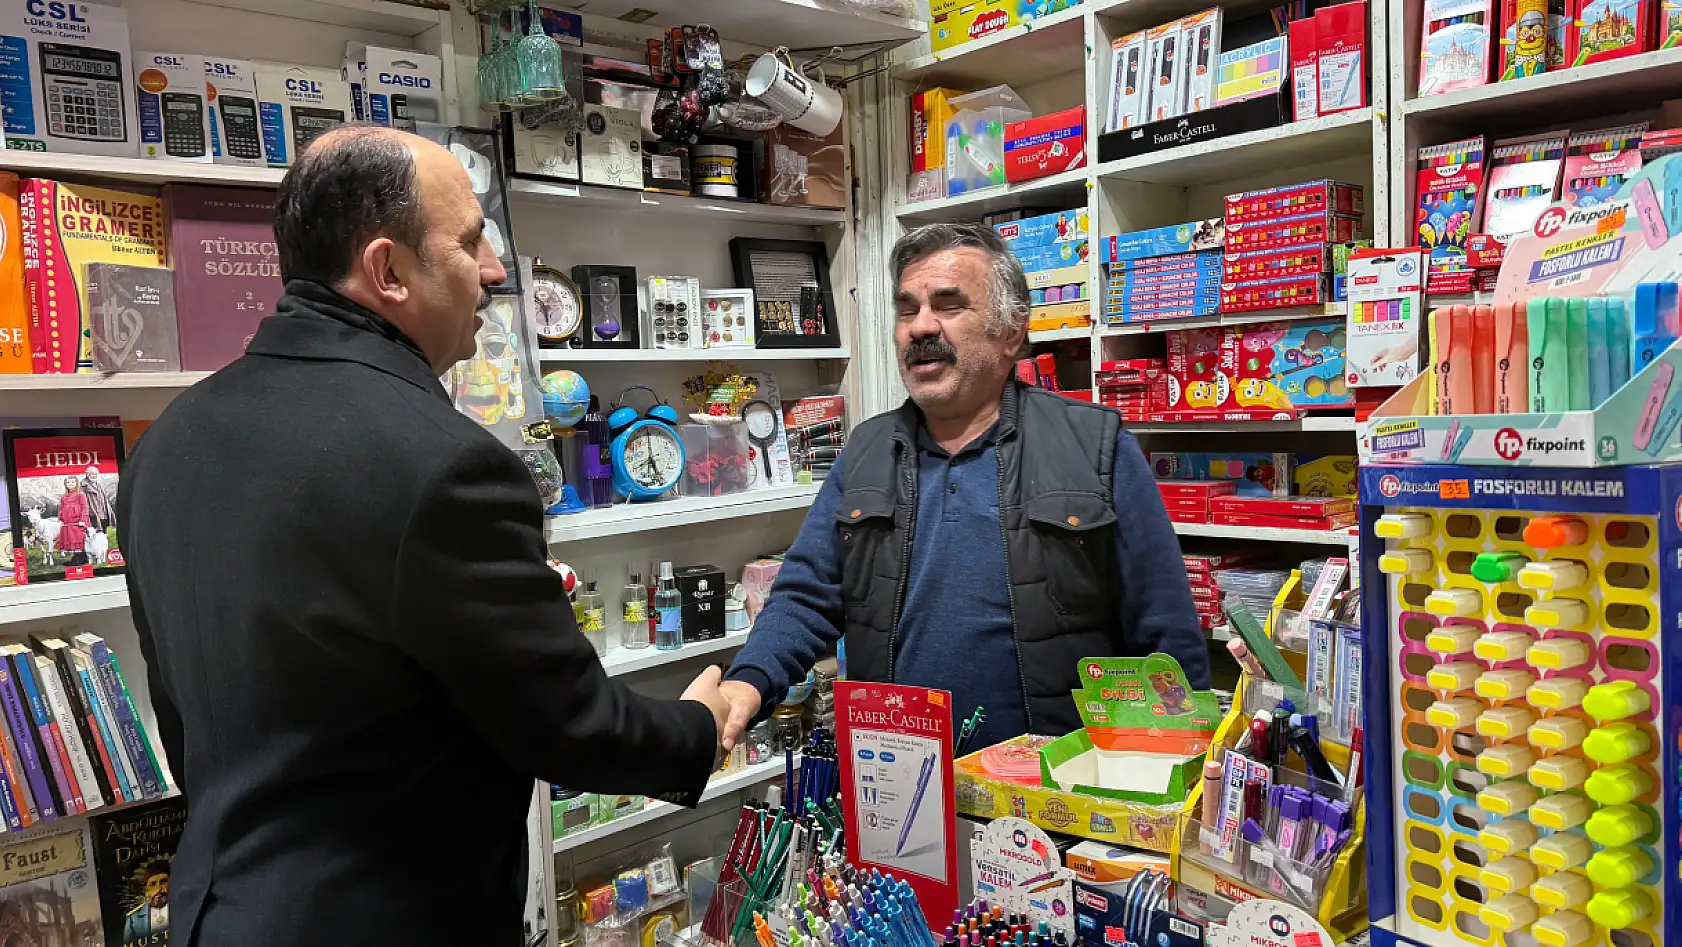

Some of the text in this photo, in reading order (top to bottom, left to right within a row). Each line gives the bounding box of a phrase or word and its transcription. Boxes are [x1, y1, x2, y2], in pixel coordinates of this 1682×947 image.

[26, 0, 86, 22] CSL
[968, 15, 1009, 35] PLAY DOUGH
[1223, 43, 1272, 63] ACRYLIC
[1318, 43, 1363, 56] FABER-CASTELL
[153, 55, 182, 66] CSL
[285, 78, 322, 93] CSL
[378, 72, 431, 89] CASIO
[1153, 123, 1217, 145] FABER-CASTELL
[20, 192, 32, 270] GRAMER
[62, 213, 155, 239] GRAMER
[62, 231, 114, 243] FUNDAMENTALS
[1544, 232, 1615, 257] PASTEL RENKLER
[1539, 243, 1614, 276] FOSFORLU KALEM
[1357, 323, 1391, 333] TANEX
[1526, 437, 1586, 455] fixpoint
[1601, 440, 1615, 450] 36
[33, 451, 100, 468] HEIDI
[1401, 481, 1439, 495] fixpoint
[1474, 478, 1625, 498] FOSFORLU KALEM
[848, 705, 942, 733] FABER-CASTELL
[2, 845, 58, 872] Faust
[1073, 859, 1096, 875] umix
[980, 870, 1013, 891] KALEM
